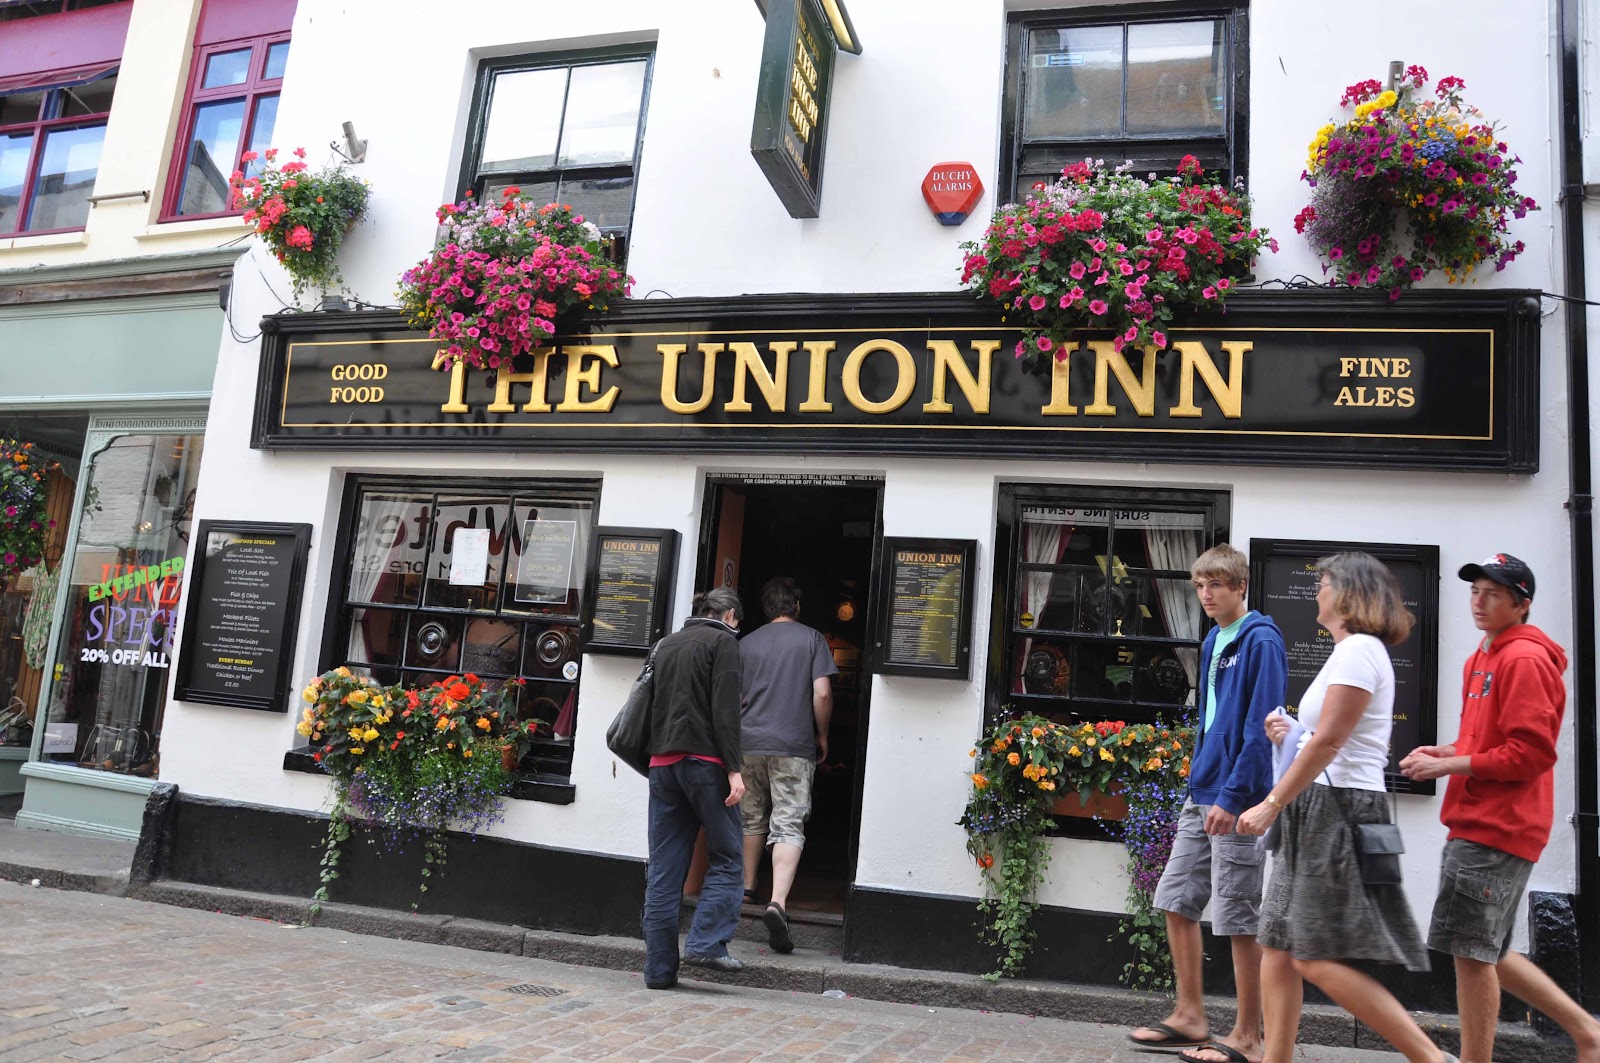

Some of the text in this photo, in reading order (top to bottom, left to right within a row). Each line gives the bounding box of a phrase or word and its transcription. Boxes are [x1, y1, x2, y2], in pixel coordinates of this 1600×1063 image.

[797, 38, 818, 92] THE
[790, 96, 811, 144] INN
[933, 170, 973, 181] DUCHY
[931, 182, 972, 191] ALARMS
[330, 363, 389, 381] GOOD
[1338, 356, 1412, 378] FINE
[430, 339, 1255, 419] THE UNION INN
[329, 386, 385, 404] FOOD
[1333, 387, 1416, 408] ALES
[603, 541, 659, 552] UNION INN
[897, 552, 962, 564] UNION INN
[88, 556, 185, 603] EXTENDED
[81, 647, 169, 668] 20% OFF ALL
[206, 662, 232, 670] Traditional
